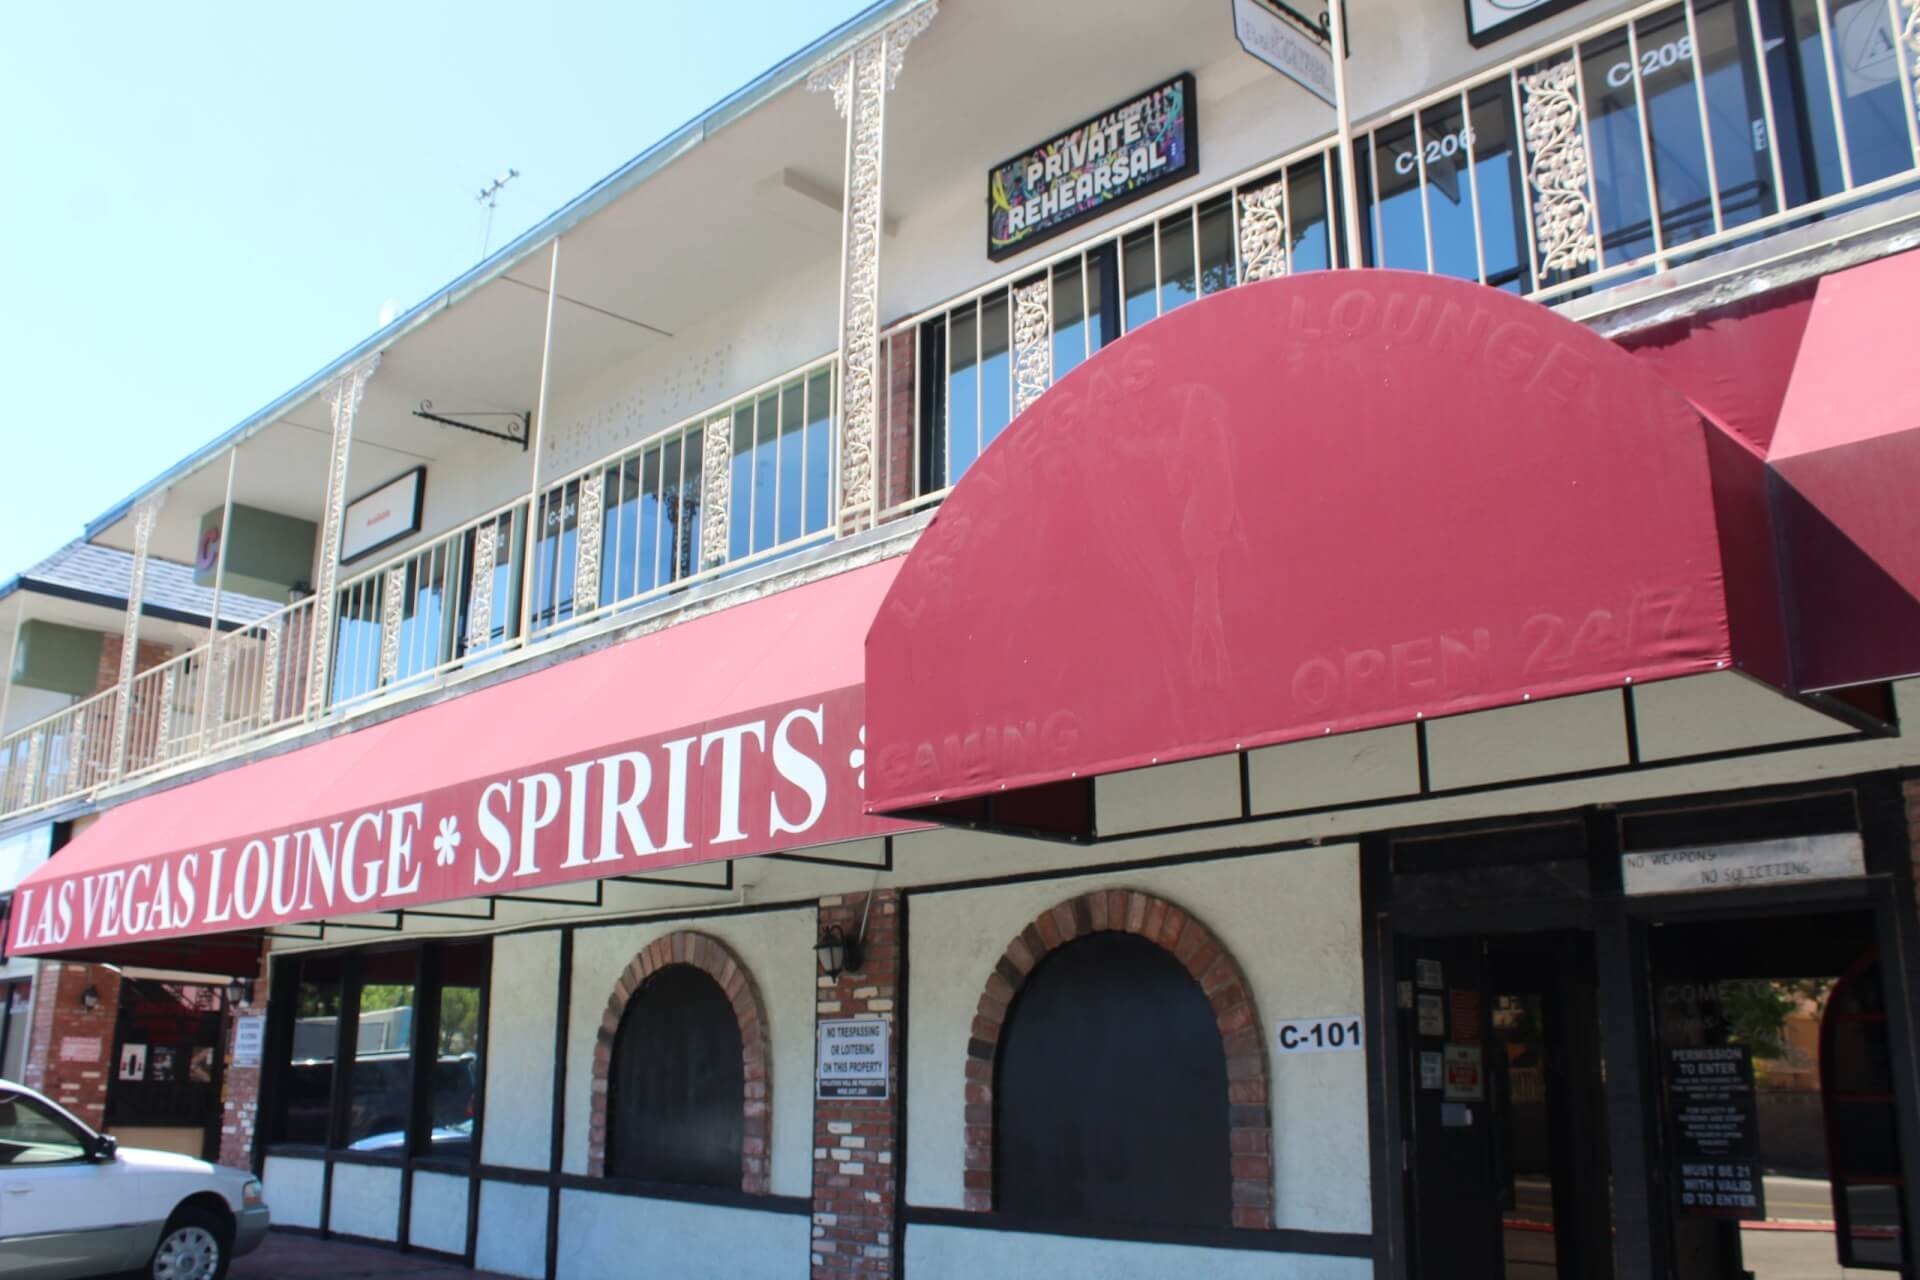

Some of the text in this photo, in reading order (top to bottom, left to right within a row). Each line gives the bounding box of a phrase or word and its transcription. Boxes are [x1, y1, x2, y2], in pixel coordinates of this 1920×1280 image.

[1607, 34, 1694, 88] C-208
[1027, 114, 1142, 191] PRIVATE
[1395, 127, 1477, 175] C-206
[1007, 141, 1168, 235] REHEARSAL
[1288, 287, 1597, 411] LOUNGE
[1291, 625, 1490, 710] OPEN
[14, 703, 828, 949] LAS VEGAS LOUNGE SPIRITS
[827, 1025, 881, 1038] NO TRESPASSING
[1280, 1021, 1360, 1050] C-101
[841, 1043, 875, 1055] LOITERING
[1671, 1049, 1743, 1061] PERMISSION
[849, 1061, 883, 1072] PROPERTY
[1680, 1062, 1737, 1075] TO ENTER
[1682, 1164, 1715, 1177] MUST
[1683, 1179, 1753, 1192] WITH VALID
[1696, 1192, 1714, 1206] TO
[1716, 1193, 1758, 1208] ENTER
